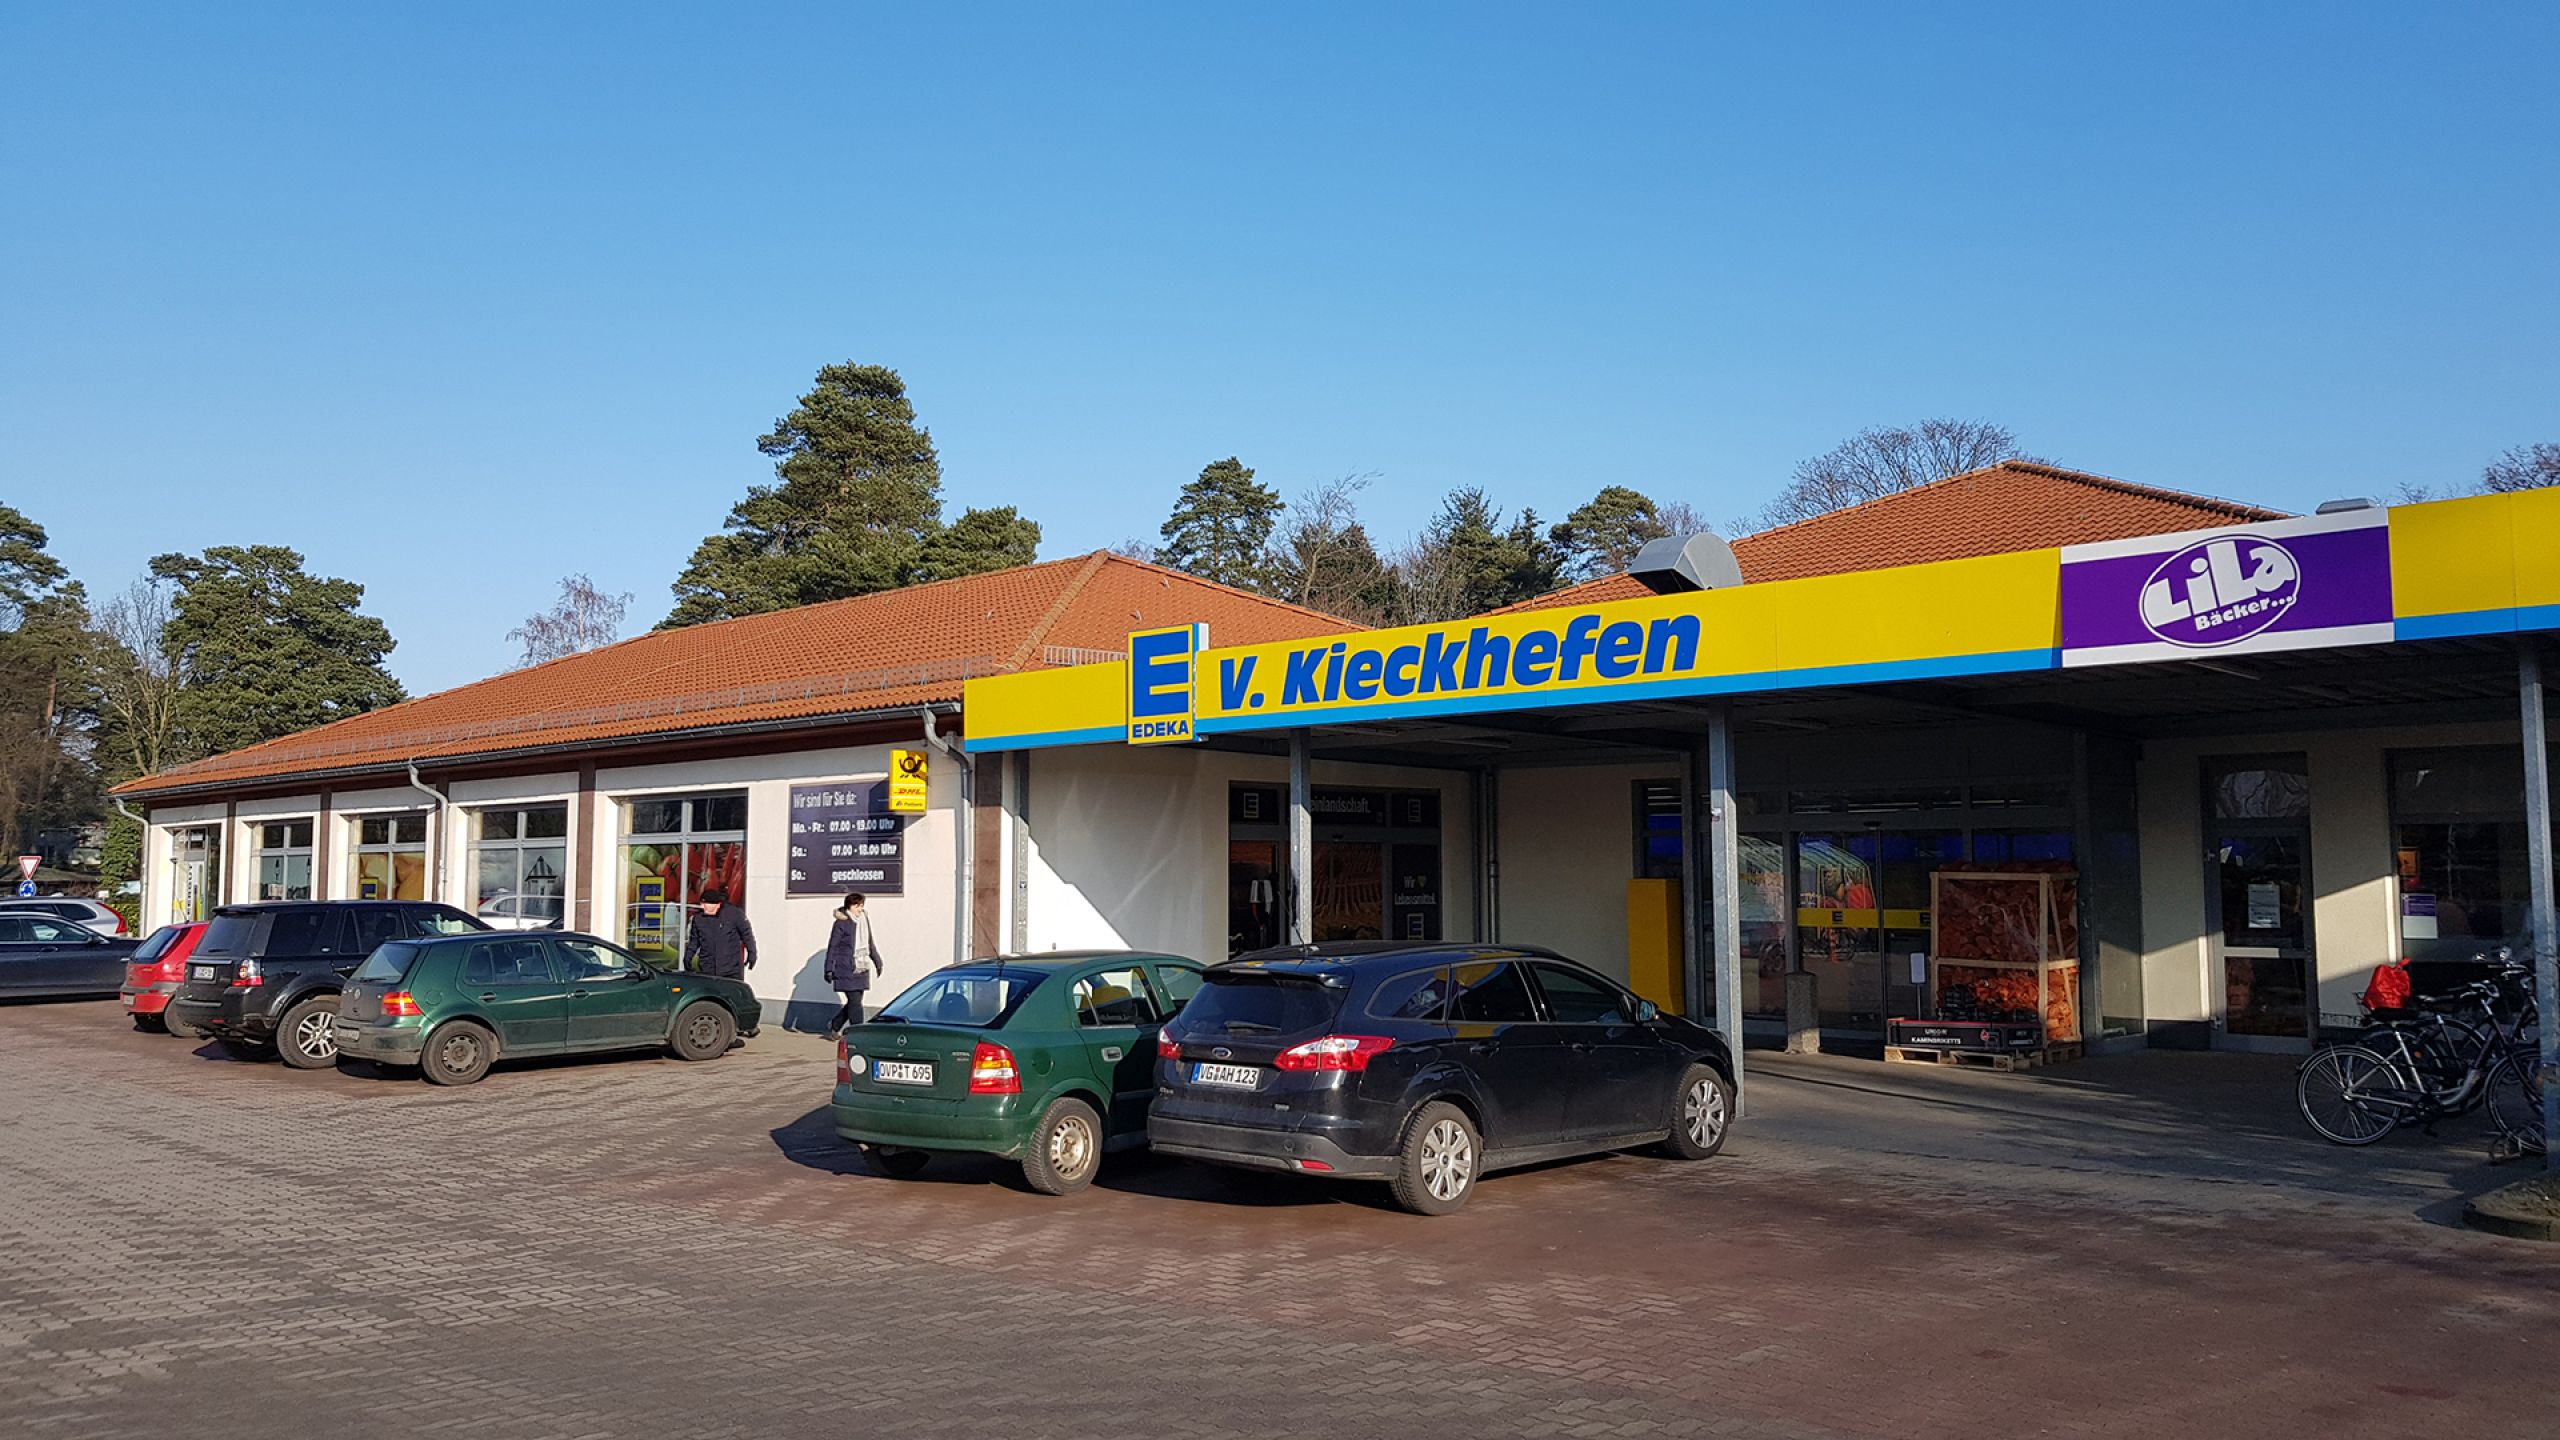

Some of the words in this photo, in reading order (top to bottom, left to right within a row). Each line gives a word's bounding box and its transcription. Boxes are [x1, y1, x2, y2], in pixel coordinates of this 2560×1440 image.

[2194, 595, 2293, 631] Bäcker...
[1281, 614, 1701, 706] Kieckhefen
[1132, 630, 1189, 717] E
[1132, 719, 1189, 738] EDEKA
[806, 792, 821, 808] sind
[879, 818, 895, 830] Uhr
[881, 843, 897, 855] Uhr
[831, 868, 885, 883] geschlossen
[1234, 1068, 1257, 1085] 123
